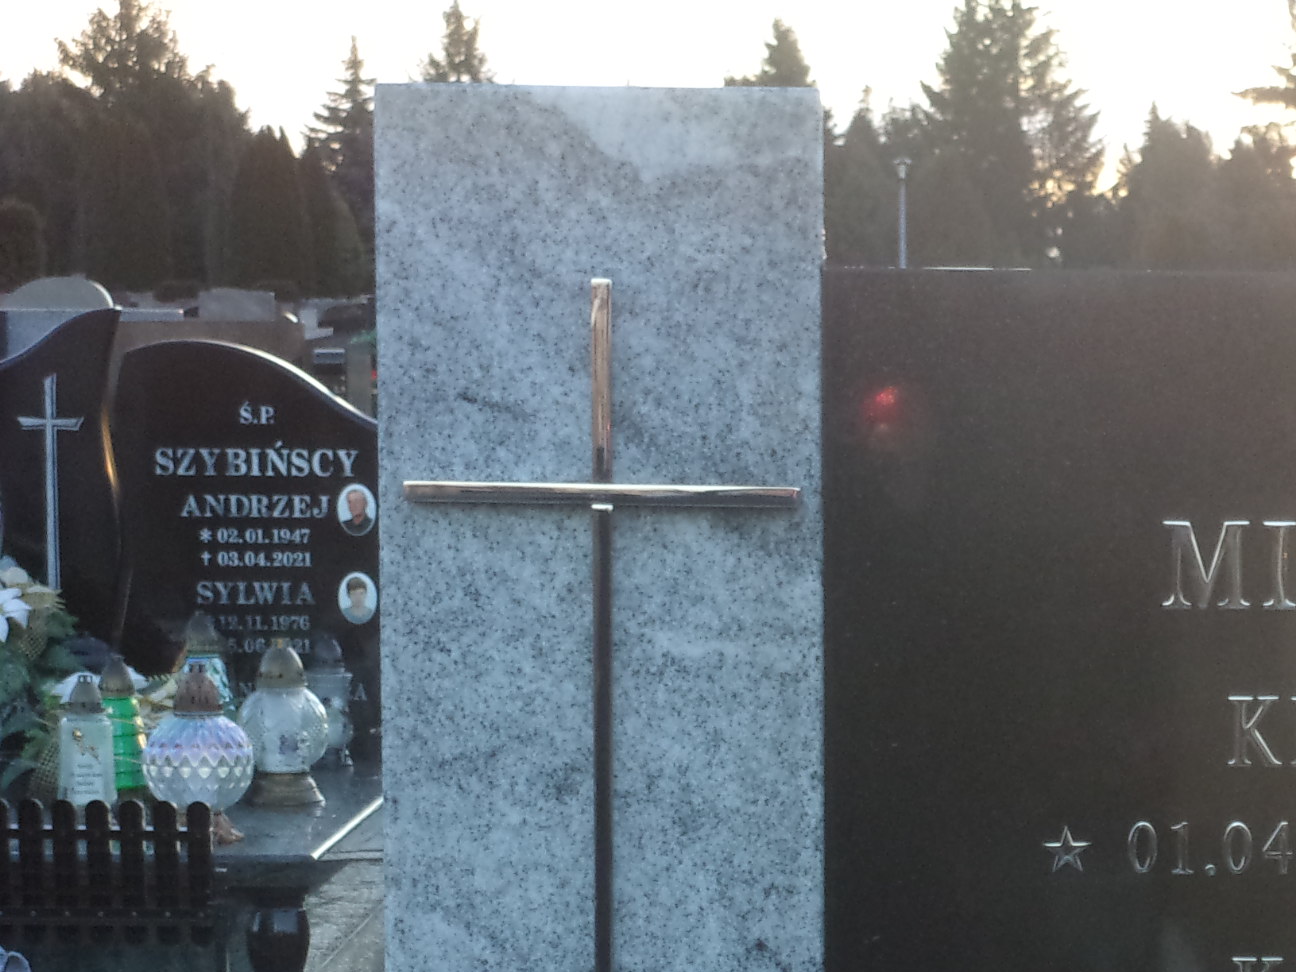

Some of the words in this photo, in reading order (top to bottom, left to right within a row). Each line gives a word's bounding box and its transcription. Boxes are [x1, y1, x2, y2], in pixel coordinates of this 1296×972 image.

[239, 400, 275, 425] Ś.P.
[154, 440, 358, 477] SZYBIŃSCY
[181, 494, 329, 518] ANDRZEJ
[216, 528, 311, 545] 02.01.1947
[217, 552, 312, 567] 03.04.2021
[196, 581, 316, 605] SYLWIA
